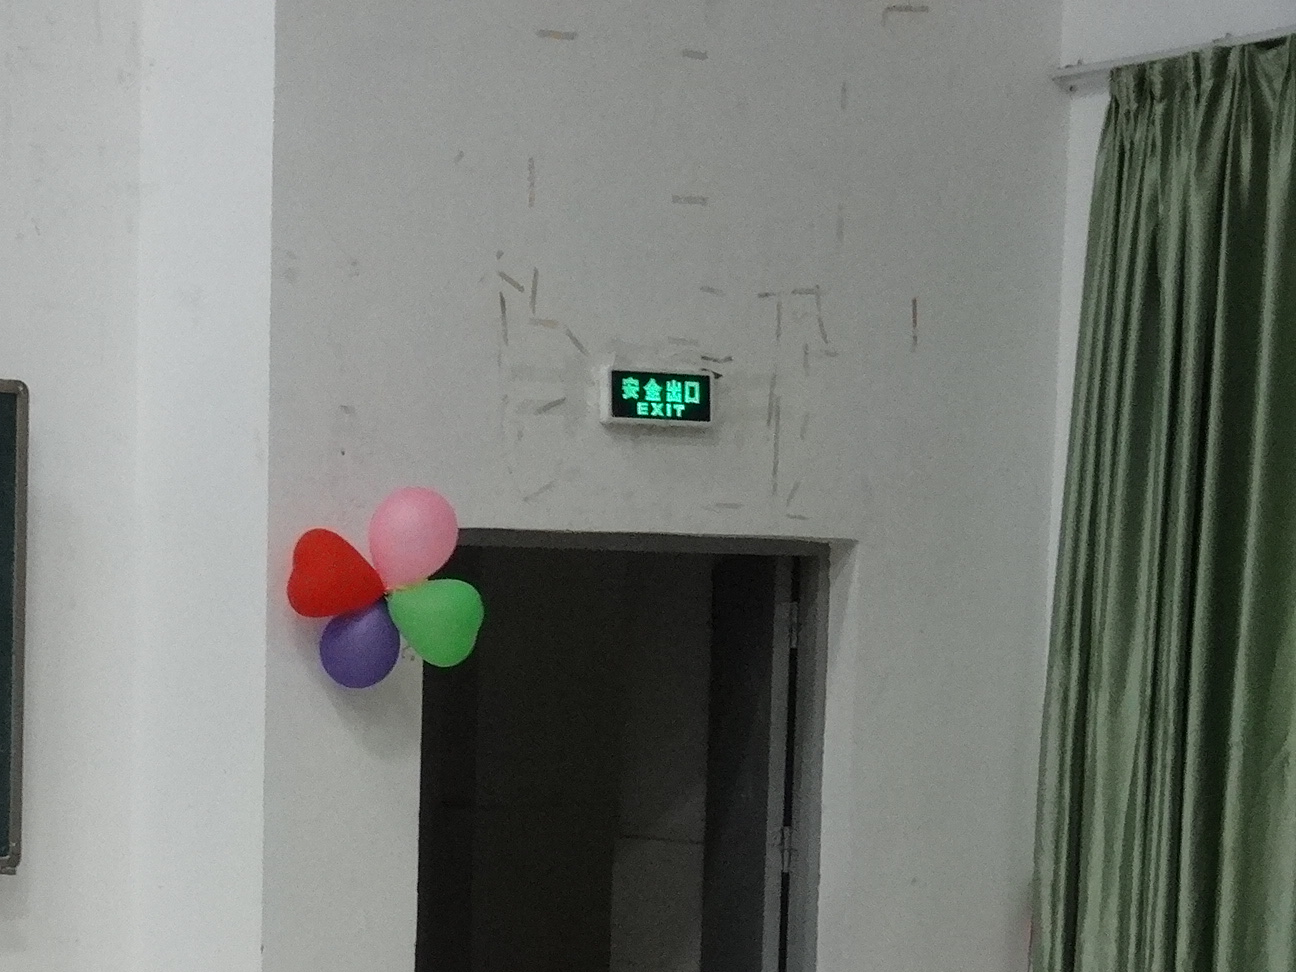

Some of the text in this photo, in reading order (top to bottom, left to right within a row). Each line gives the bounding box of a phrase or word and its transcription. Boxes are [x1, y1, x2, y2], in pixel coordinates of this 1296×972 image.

[621, 376, 701, 404] 安全出口
[636, 401, 686, 418] EXIT
